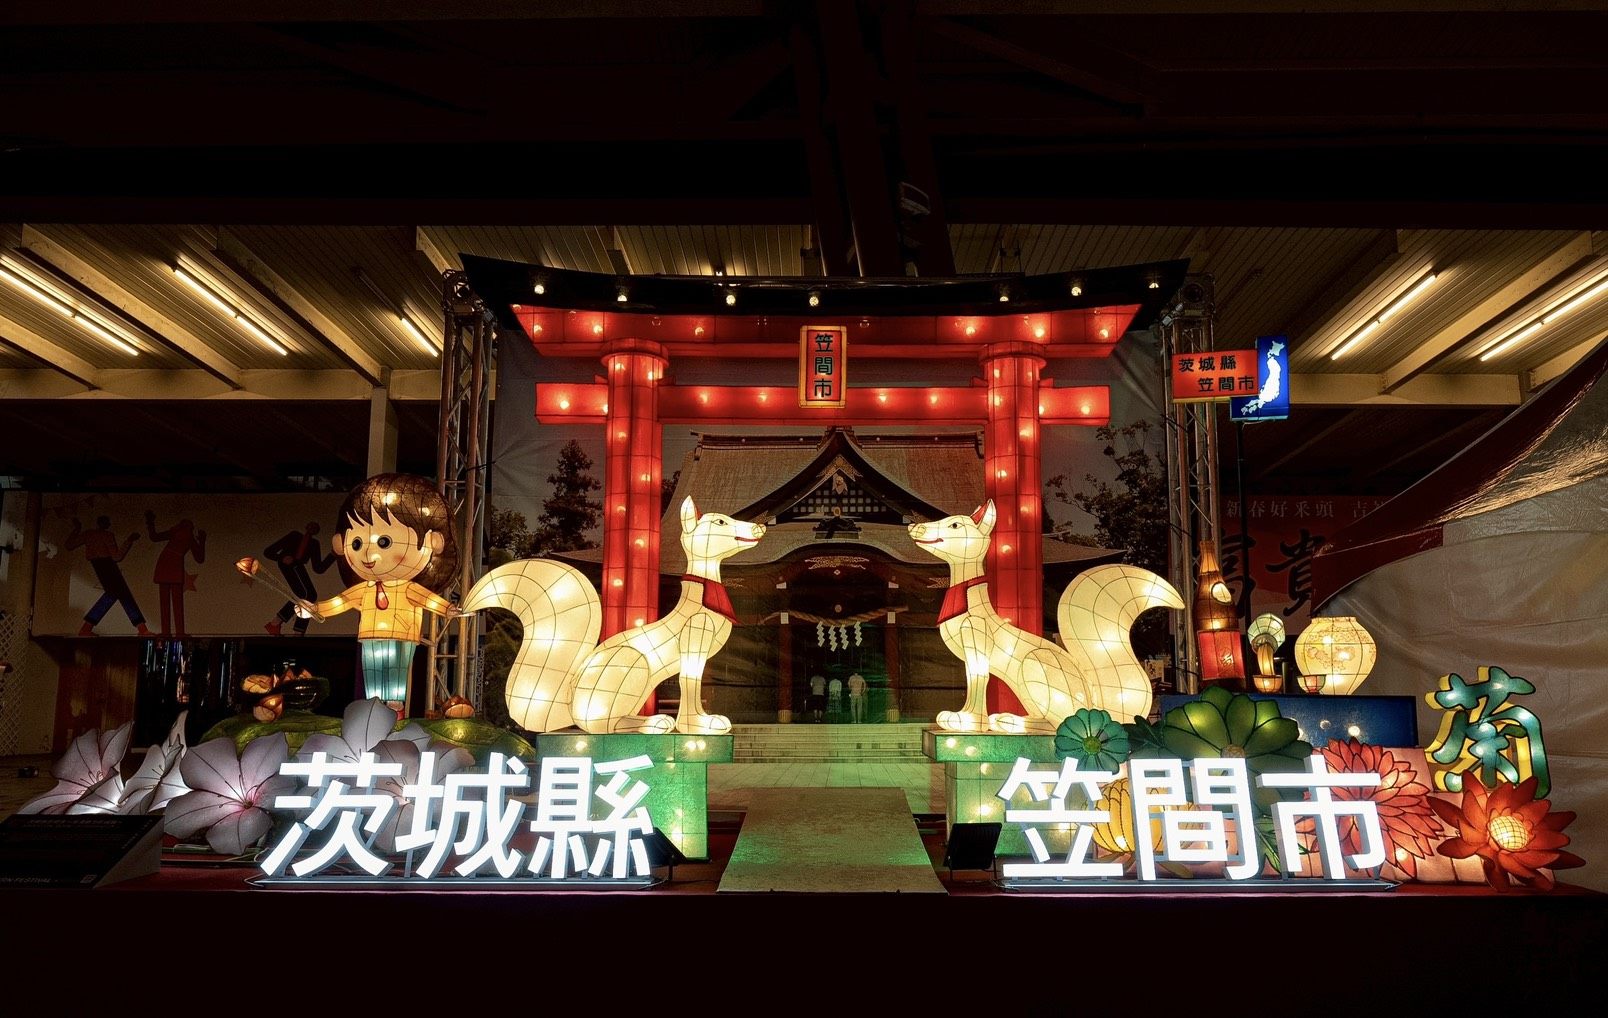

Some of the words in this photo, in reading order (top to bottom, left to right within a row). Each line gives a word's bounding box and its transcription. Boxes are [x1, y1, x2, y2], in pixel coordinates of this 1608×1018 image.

[814, 333, 834, 398] 笠間市
[1179, 355, 1237, 372] 茨城縣
[1198, 376, 1255, 392] 笠間市
[259, 751, 656, 880] 茨城縣
[998, 755, 1388, 882] 笠間市
